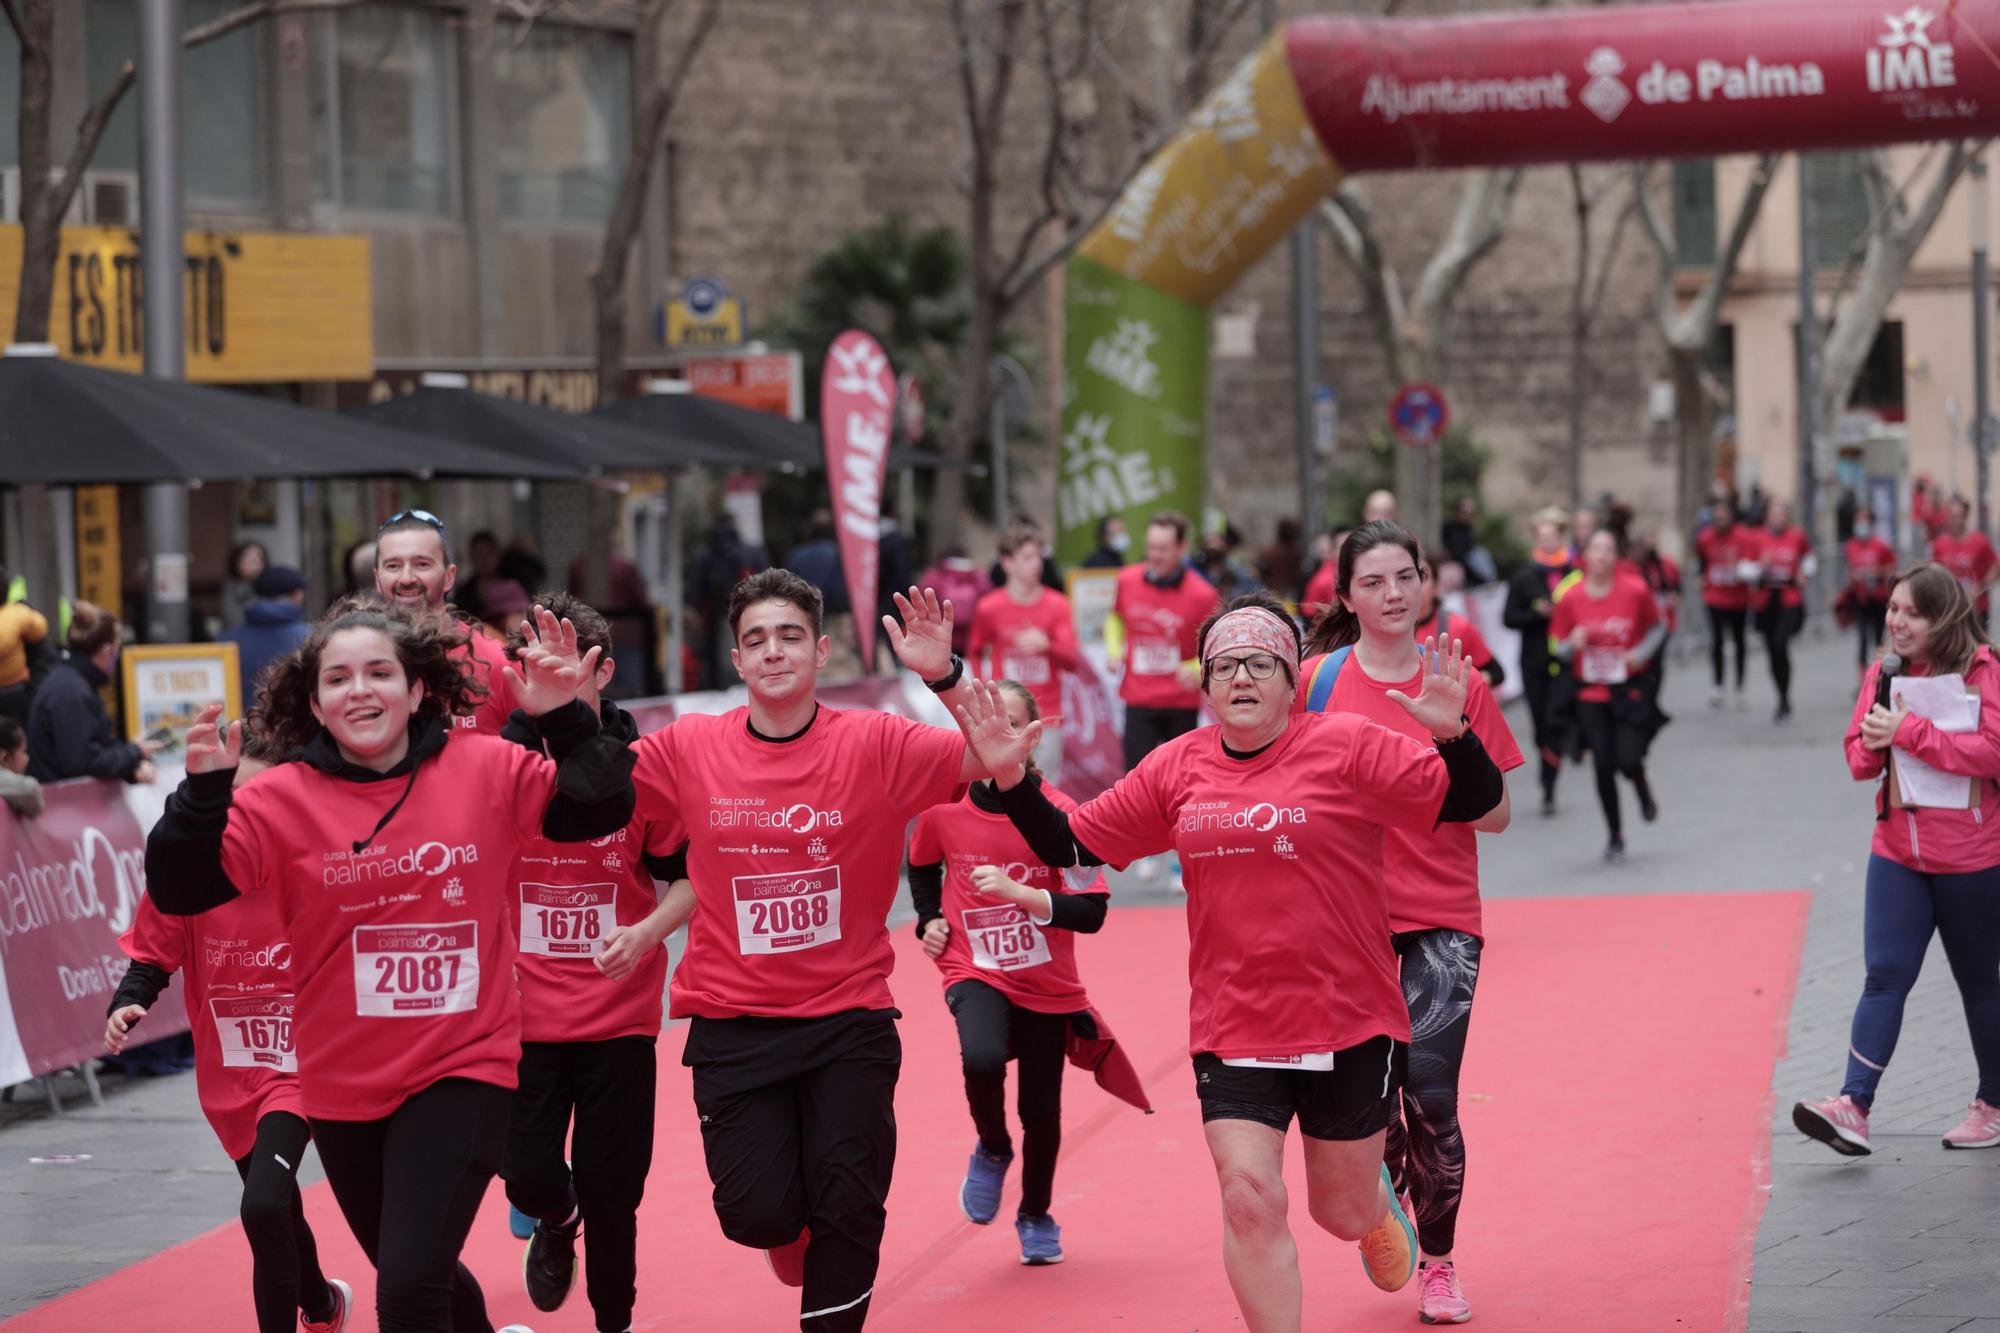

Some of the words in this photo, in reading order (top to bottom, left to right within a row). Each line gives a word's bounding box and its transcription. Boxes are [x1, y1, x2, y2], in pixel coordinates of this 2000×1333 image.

[1865, 41, 1957, 93] IME
[1361, 72, 1571, 124] Ajuntament
[1637, 60, 1691, 104] de
[1697, 56, 1825, 101] Palma
[841, 410, 887, 541] IME
[1060, 451, 1162, 529] IME
[734, 796, 766, 807] popular
[1198, 800, 1230, 811] popular
[602, 858, 622, 868] IME
[807, 845, 828, 855] IME
[1272, 842, 1295, 853] IME
[537, 908, 600, 940] 1678
[749, 894, 829, 935] 2088
[979, 924, 1036, 956] 1758
[375, 953, 461, 994] 2087
[234, 1018, 295, 1053] 1679
